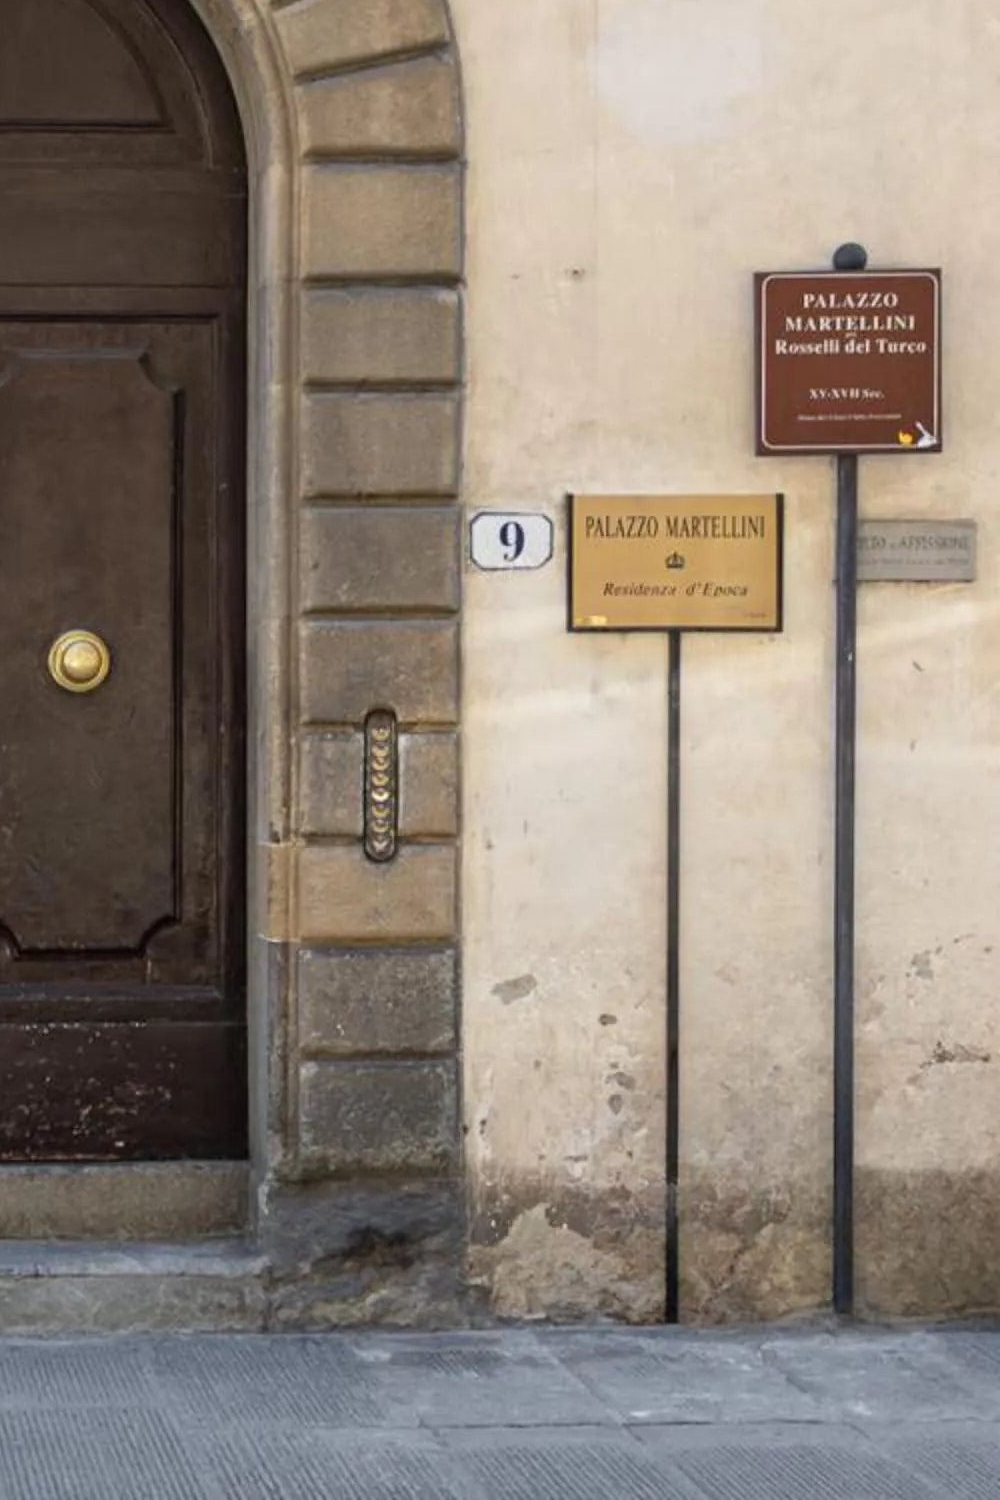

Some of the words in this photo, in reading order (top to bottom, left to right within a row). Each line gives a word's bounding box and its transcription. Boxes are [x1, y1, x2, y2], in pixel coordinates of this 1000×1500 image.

[803, 292, 898, 309] PALAZZO
[785, 315, 915, 331] MARTELLINI
[775, 339, 839, 355] Rosselli
[845, 339, 870, 354] del
[876, 338, 927, 354] Turco
[585, 515, 659, 538] PALAZZO
[665, 515, 765, 538] MARTELLINI
[499, 521, 525, 562] 9
[603, 582, 676, 596] Residenza
[686, 582, 748, 597] d'Epoca
